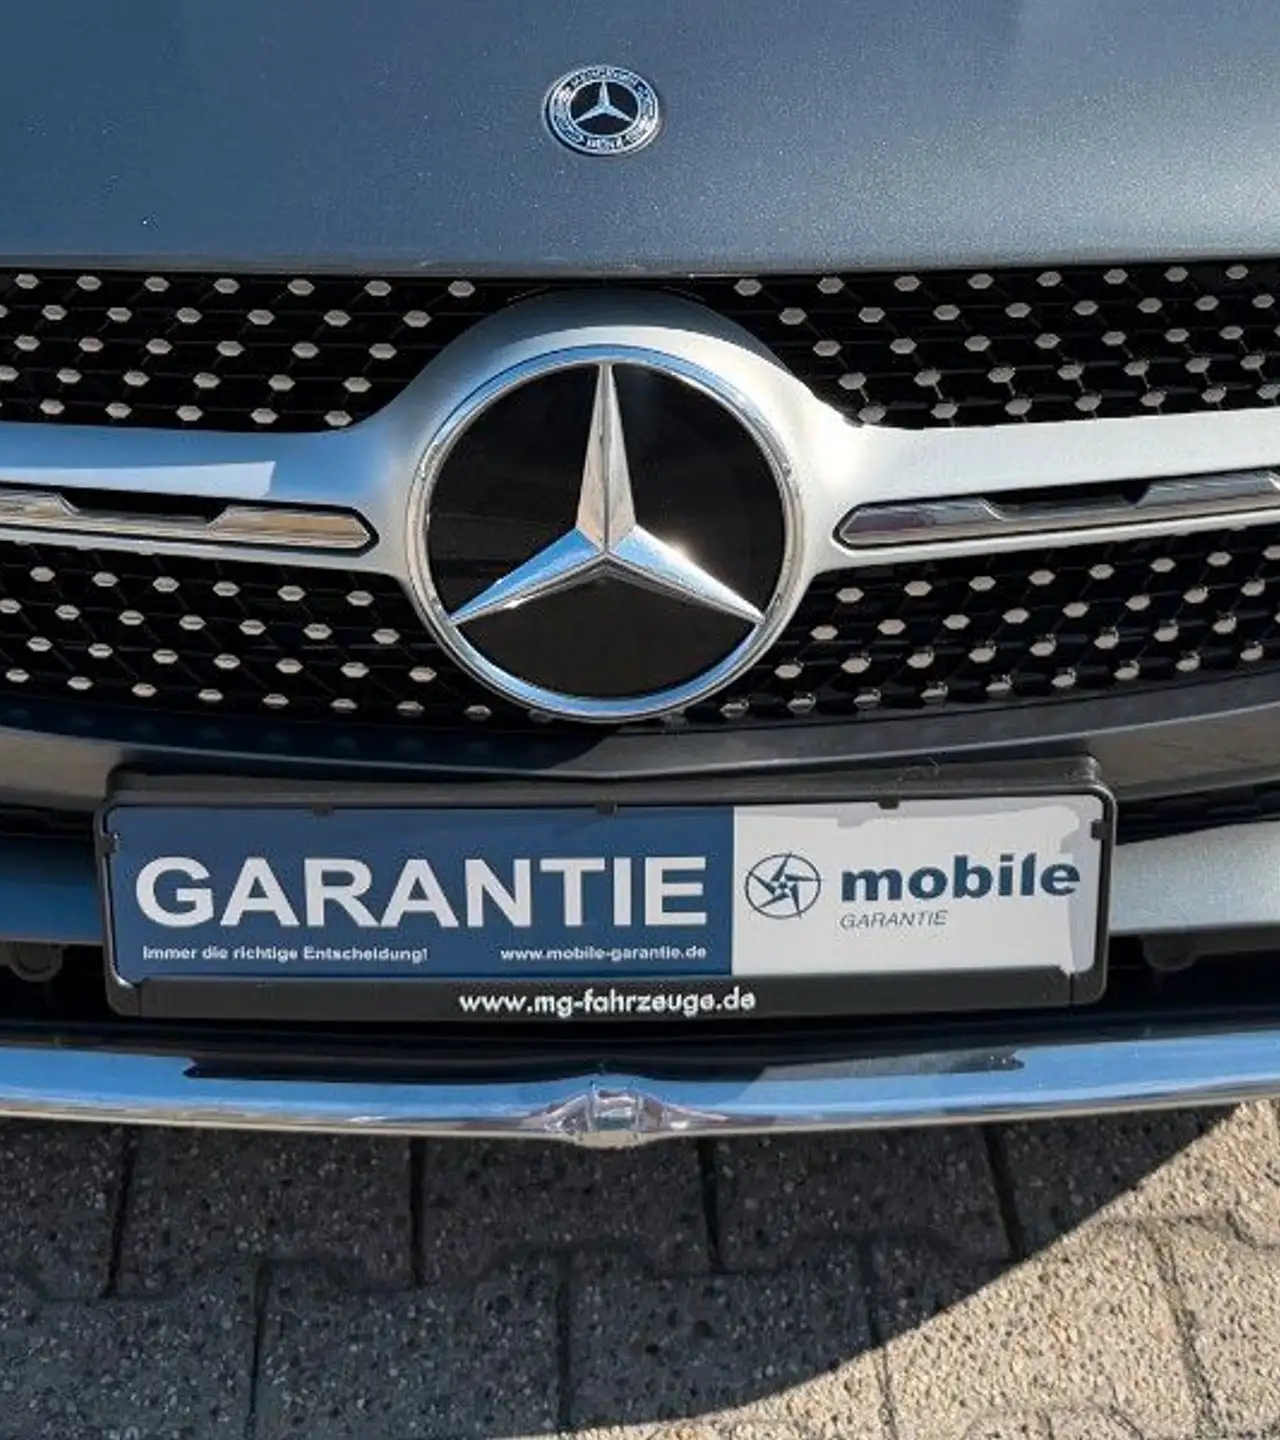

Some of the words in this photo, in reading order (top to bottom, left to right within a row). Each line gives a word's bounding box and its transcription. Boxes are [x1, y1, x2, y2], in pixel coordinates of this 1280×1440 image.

[841, 853, 1081, 902] mobile
[135, 856, 707, 928] GARANTIE
[839, 909, 949, 930] GARANTIE
[142, 945, 197, 960] Immer
[202, 945, 228, 960] die
[233, 945, 297, 964] richtige
[303, 945, 428, 964] Entscheidung!
[500, 945, 707, 962] www.mobile-garantie.de
[459, 985, 756, 1018] www.mg-fahrzeuge.de
